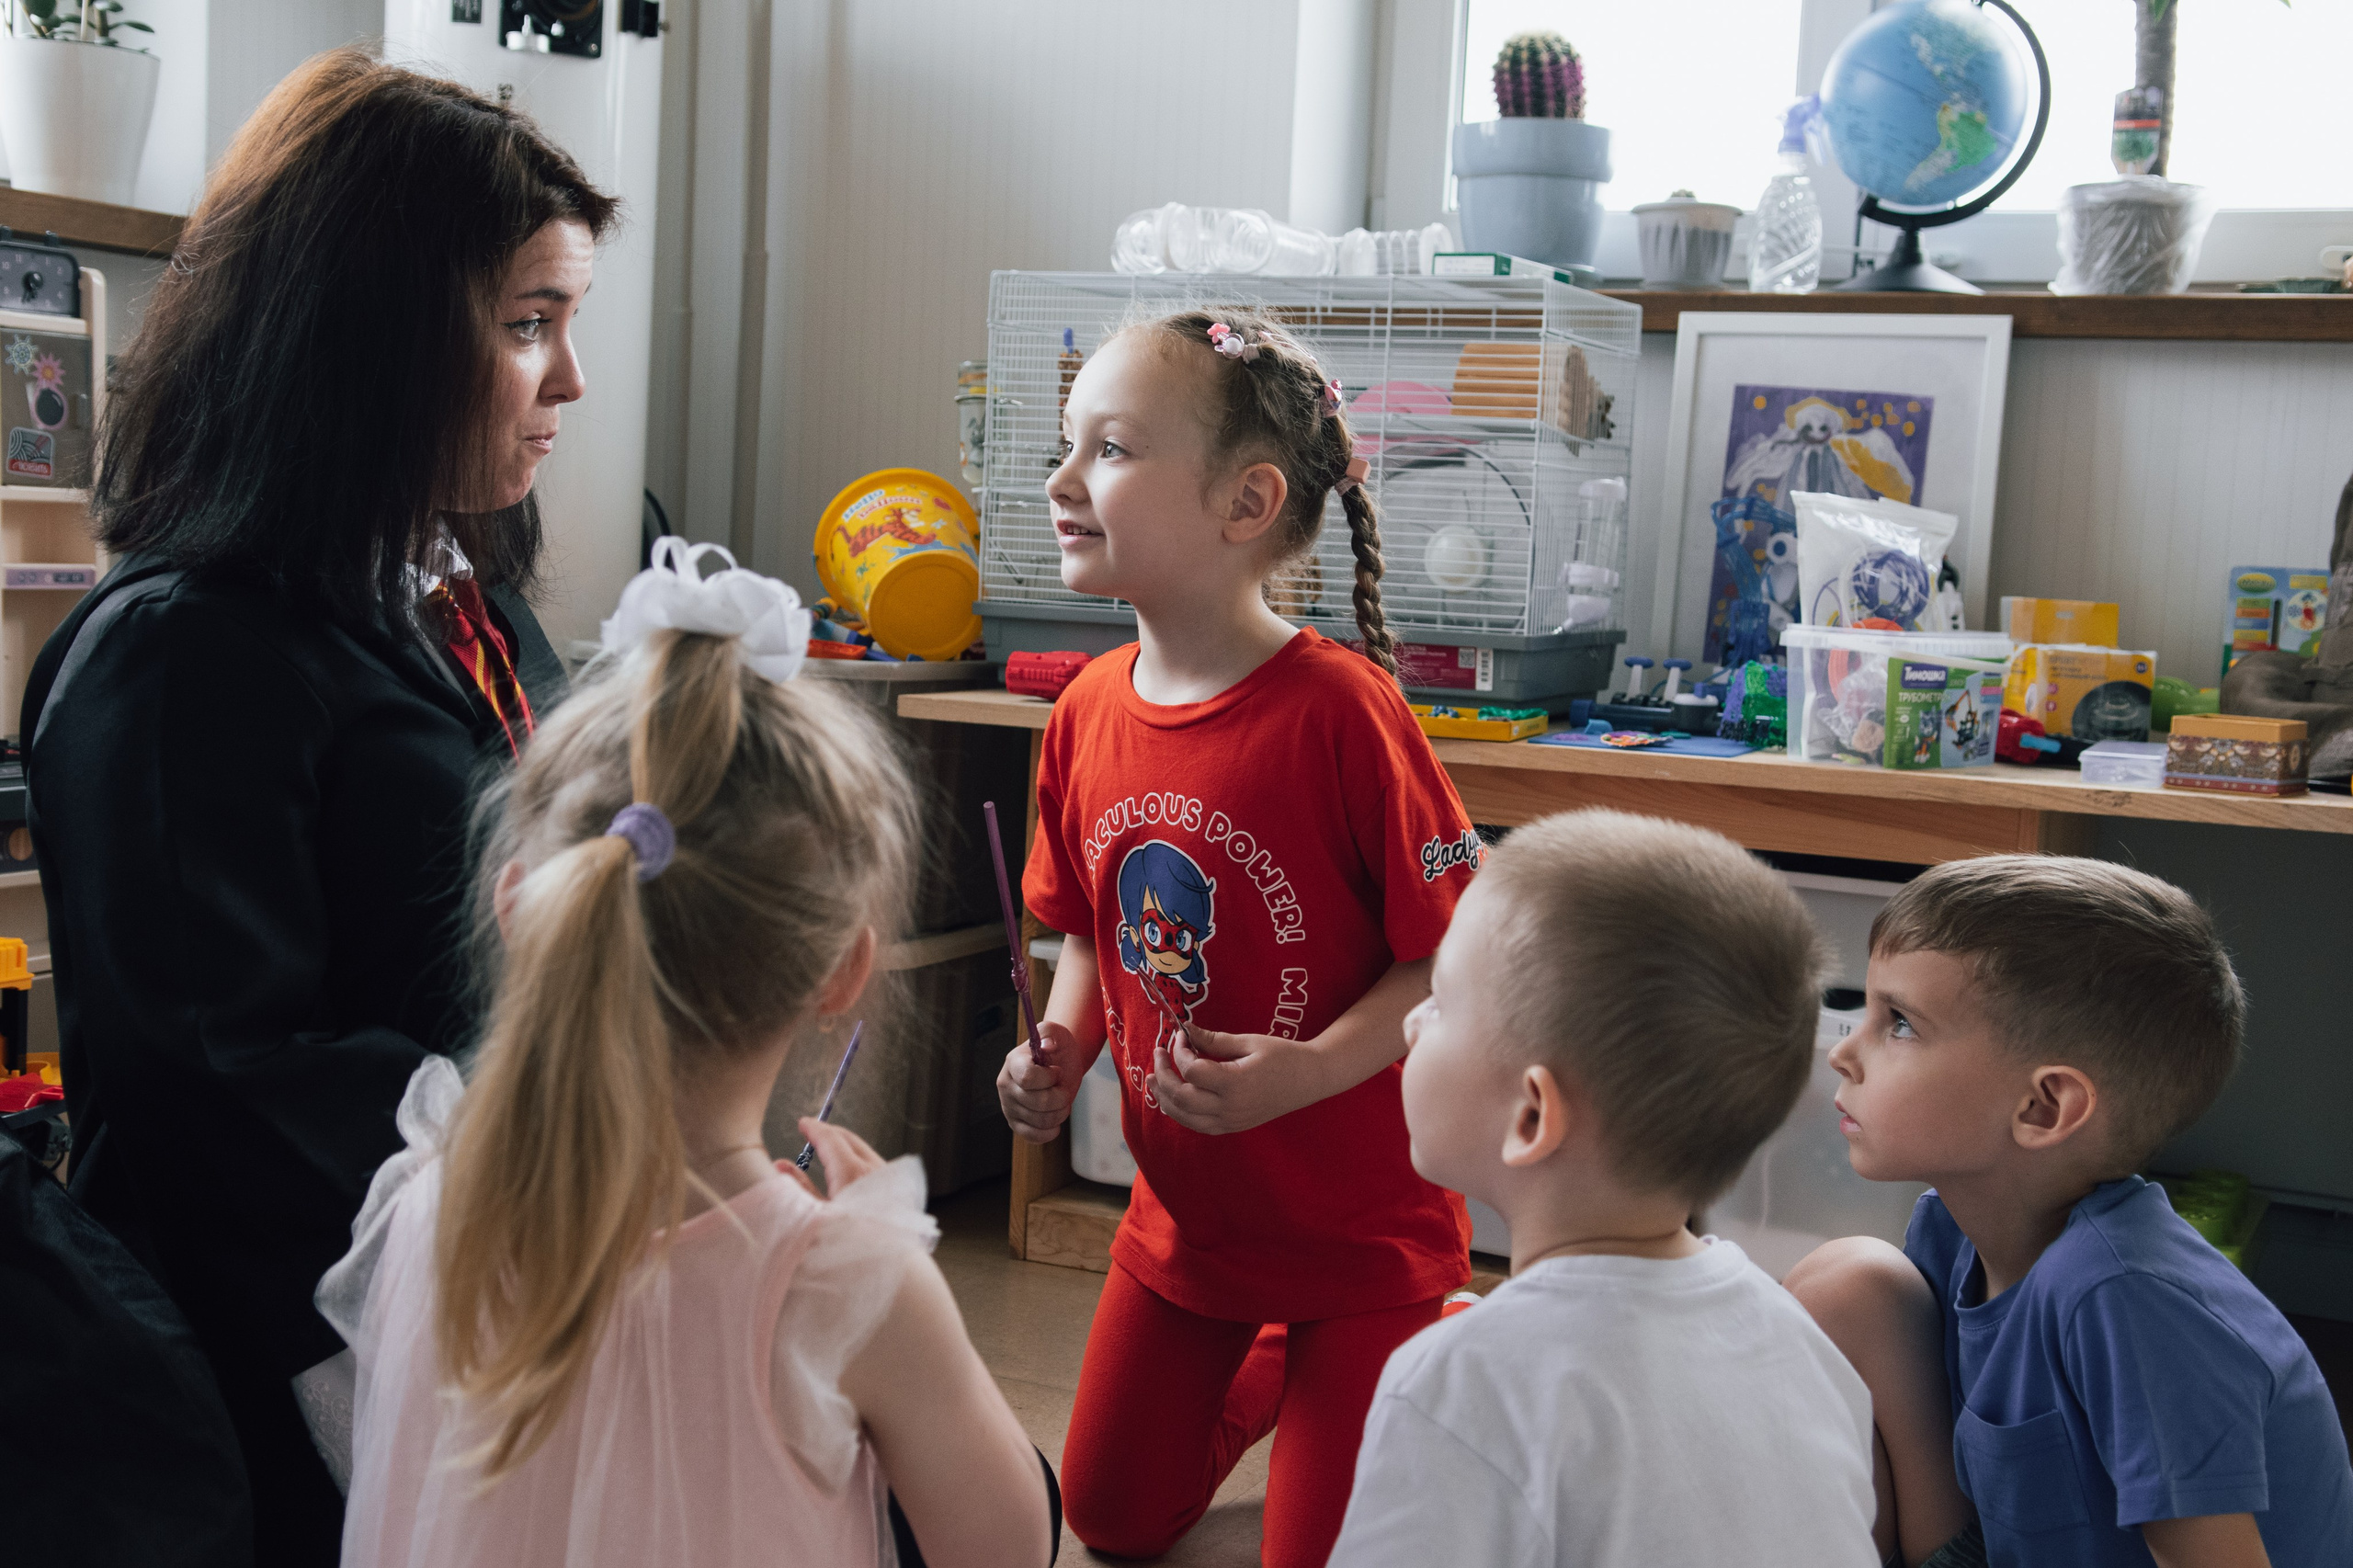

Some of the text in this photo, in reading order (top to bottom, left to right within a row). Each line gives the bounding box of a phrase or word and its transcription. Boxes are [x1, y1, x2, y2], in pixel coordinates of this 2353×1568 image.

[1085, 791, 1306, 944] ACULOUS POWER!
[1267, 967, 1308, 1041] MIR
